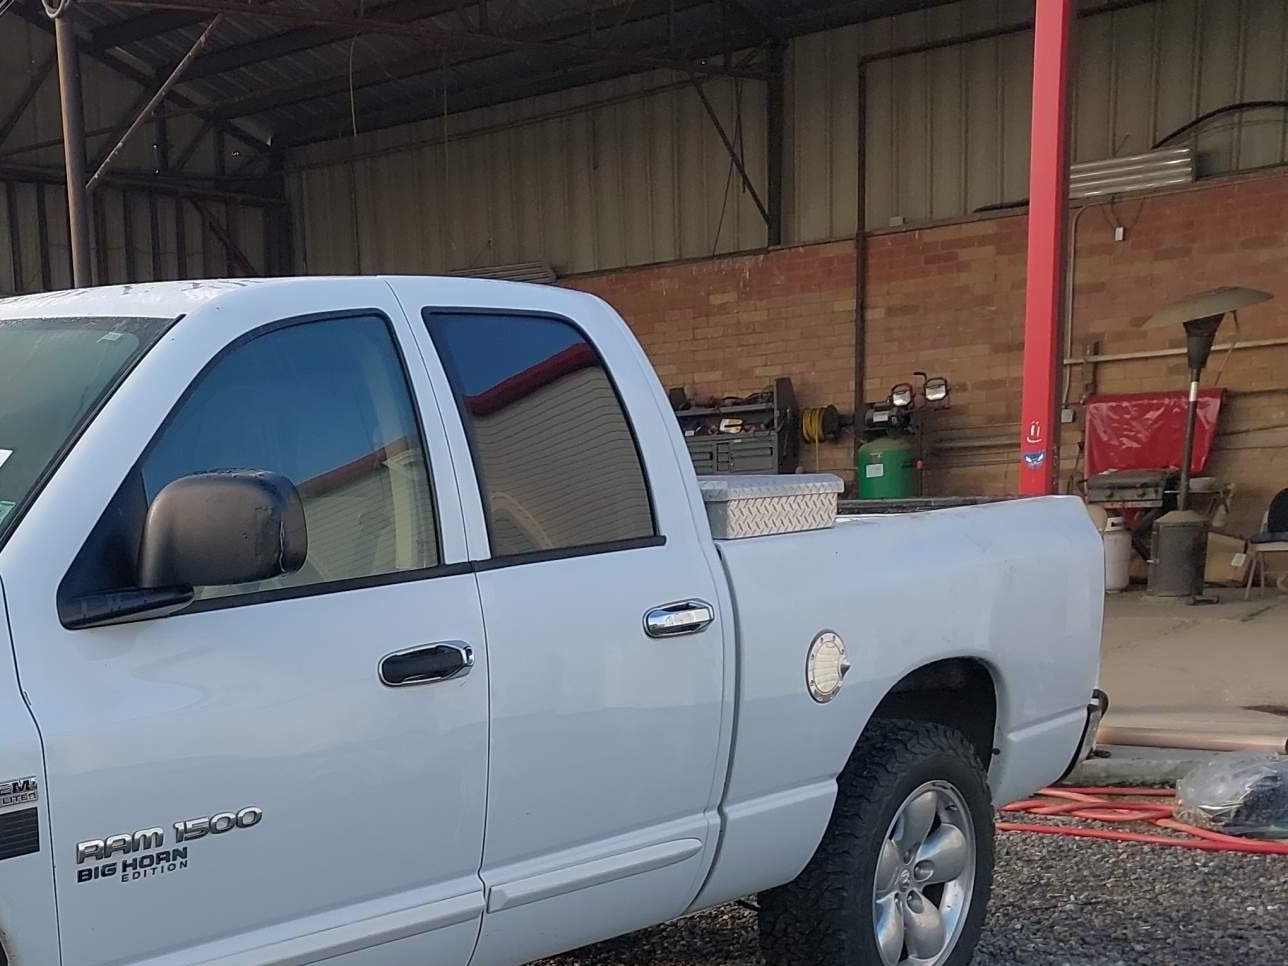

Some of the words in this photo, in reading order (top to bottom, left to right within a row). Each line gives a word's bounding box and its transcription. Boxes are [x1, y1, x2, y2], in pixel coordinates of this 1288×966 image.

[76, 826, 164, 865] RAM
[173, 806, 263, 844] 1500
[77, 862, 117, 883] BIG
[122, 846, 188, 873] HORN
[121, 859, 188, 883] EDITION
